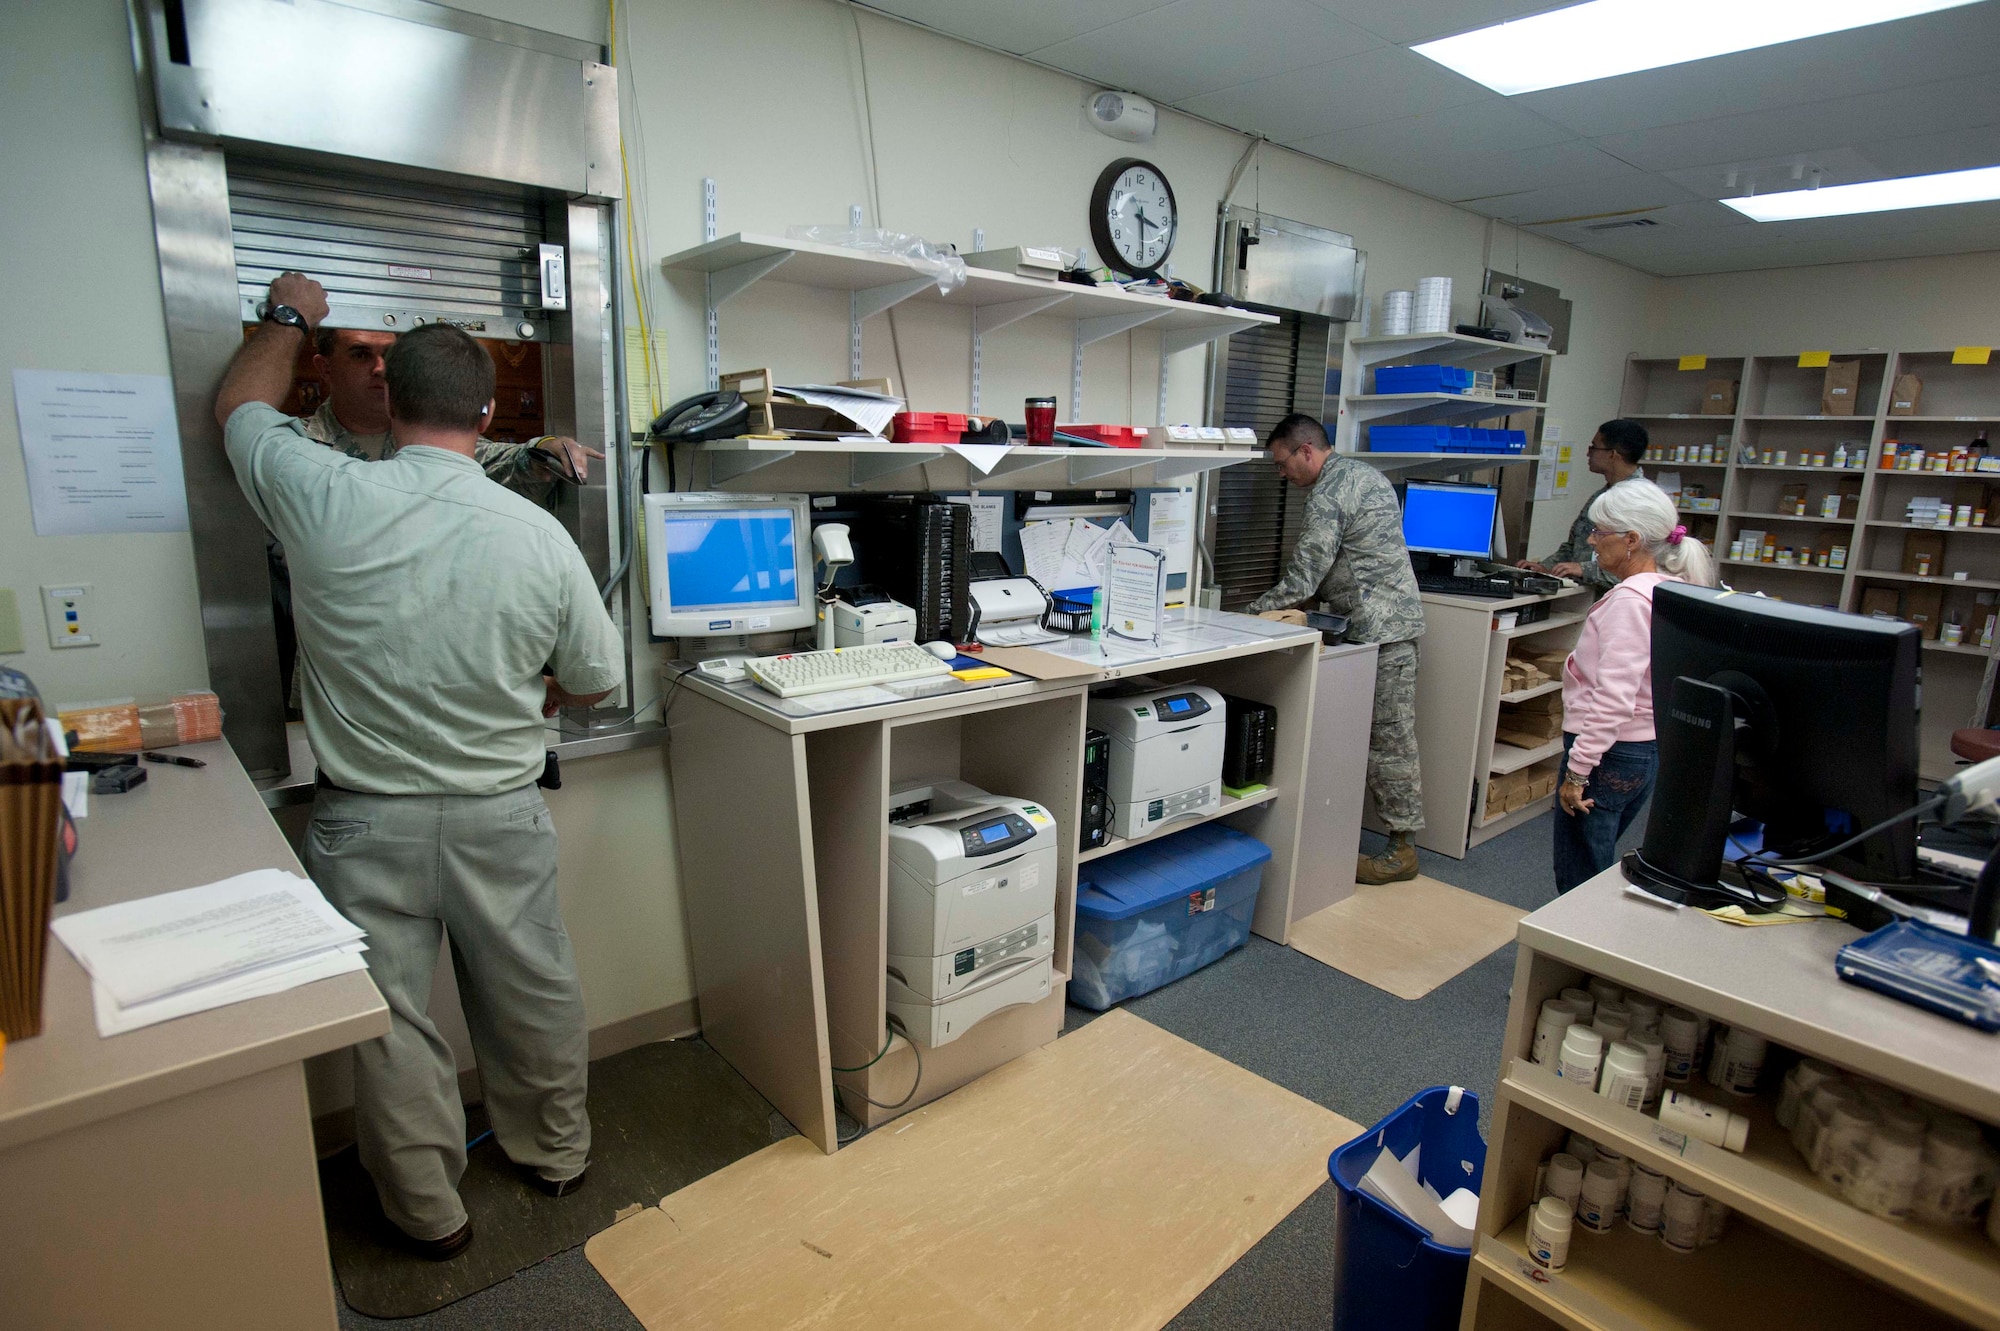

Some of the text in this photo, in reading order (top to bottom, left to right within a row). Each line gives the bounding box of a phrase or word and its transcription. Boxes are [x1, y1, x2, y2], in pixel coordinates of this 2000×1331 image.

[1125, 176, 1131, 187] 11
[1136, 174, 1145, 184] 12
[1115, 190, 1123, 200] 10
[1159, 198, 1165, 207] 2
[1111, 209, 1118, 219] 9
[1162, 216, 1168, 226] 3
[1114, 229, 1121, 239] 8
[1158, 235, 1164, 245] 4
[1124, 244, 1131, 254] 7
[1148, 247, 1155, 257] 5
[1136, 250, 1143, 261] 6
[1671, 708, 1712, 729] SAMSUNG
